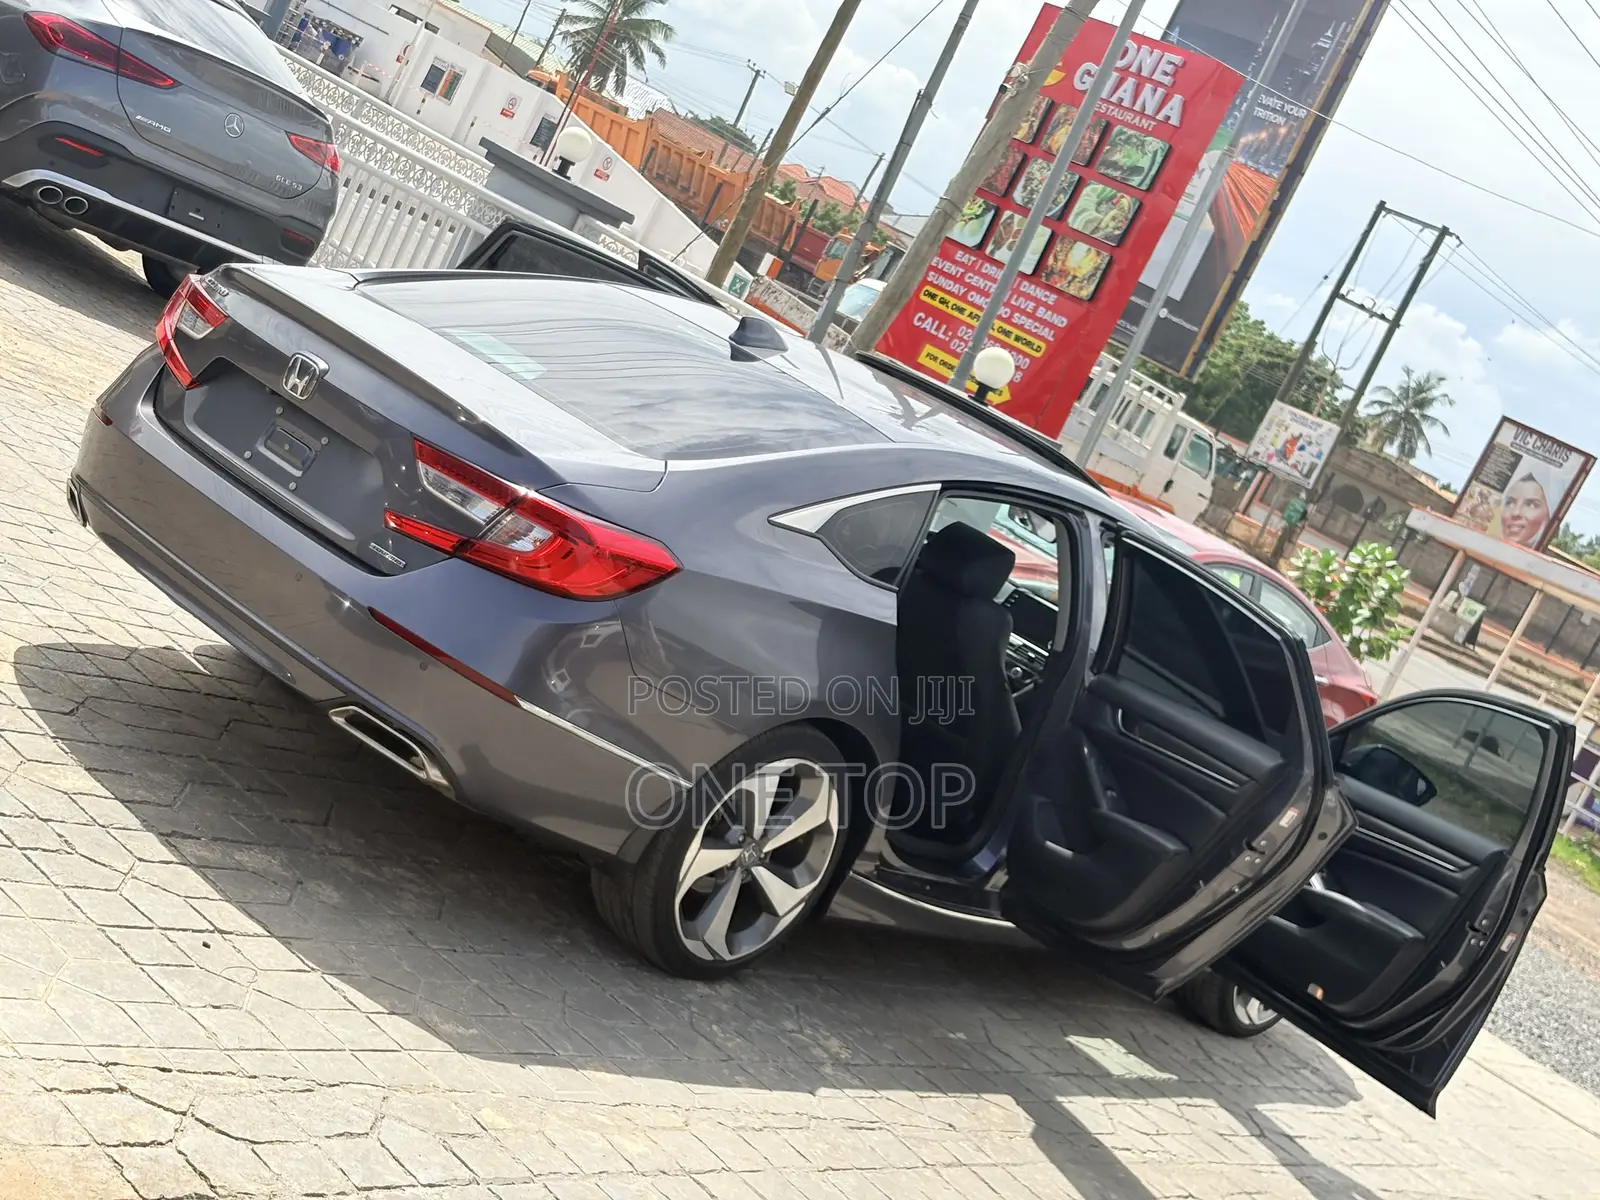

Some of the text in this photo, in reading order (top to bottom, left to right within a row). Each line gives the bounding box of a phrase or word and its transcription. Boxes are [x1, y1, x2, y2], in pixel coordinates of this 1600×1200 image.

[1094, 102, 1157, 131] ESTAURANT
[1253, 107, 1287, 126] TRITION
[1283, 102, 1308, 119] YOUR
[931, 256, 965, 280] EVENT
[1010, 294, 1037, 314] LIVE
[1035, 307, 1069, 329] BAND
[954, 250, 976, 266] EAT
[1019, 280, 1058, 306] DANCE
[922, 288, 938, 302] ONE
[950, 301, 967, 316] ONE
[996, 325, 1014, 340] ONE
[1014, 335, 1043, 354] WORLD
[926, 271, 968, 297] SUNDAY
[1011, 312, 1056, 342] SPECIAL
[912, 312, 953, 342] CALL:
[924, 352, 939, 365] FOR
[1511, 426, 1532, 447] VIC
